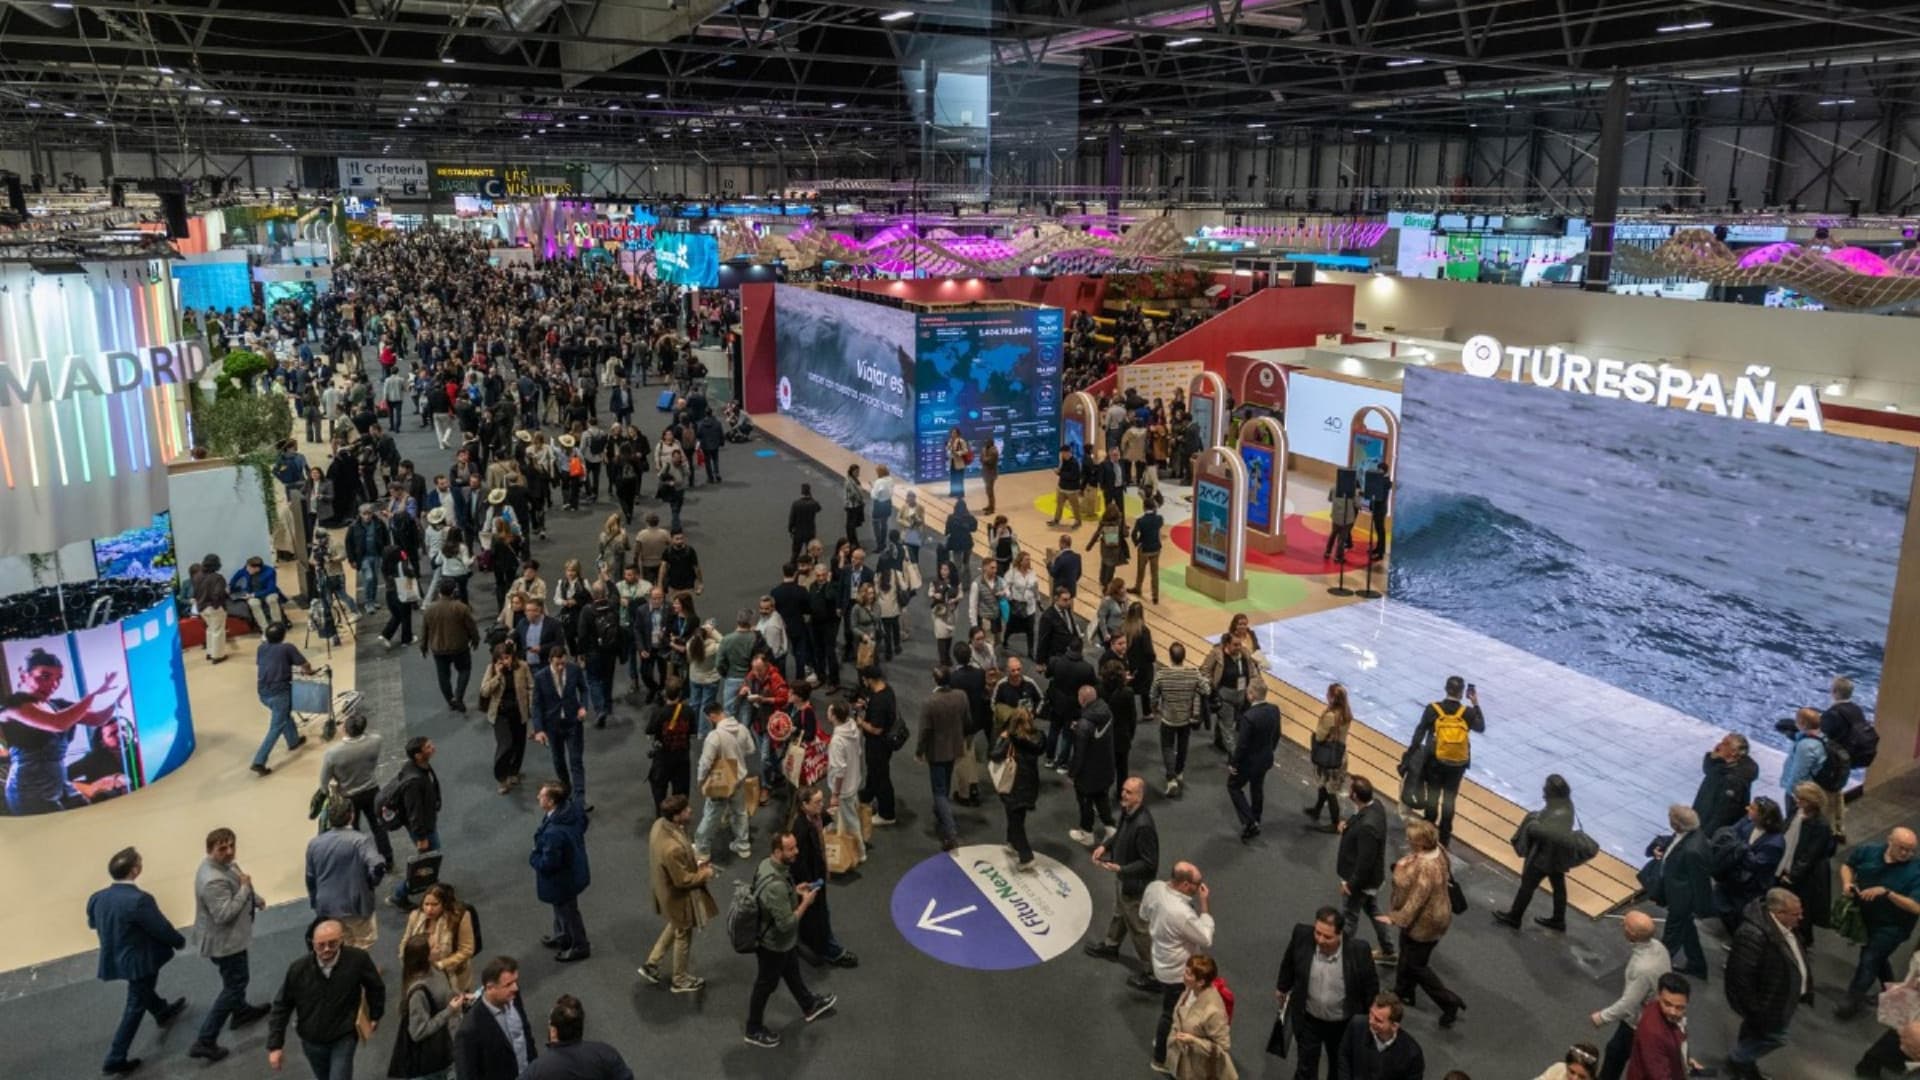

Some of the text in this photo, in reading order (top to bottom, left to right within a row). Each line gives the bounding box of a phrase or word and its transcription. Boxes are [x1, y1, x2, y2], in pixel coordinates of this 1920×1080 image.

[437, 168, 495, 177] RESTAURANTE
[505, 169, 528, 181] LAS
[485, 180, 501, 198] C
[0, 339, 212, 407] MADRID
[857, 360, 904, 394] Viajar es
[1505, 345, 1824, 431] TURESPAÑA
[1324, 416, 1343, 429] 40
